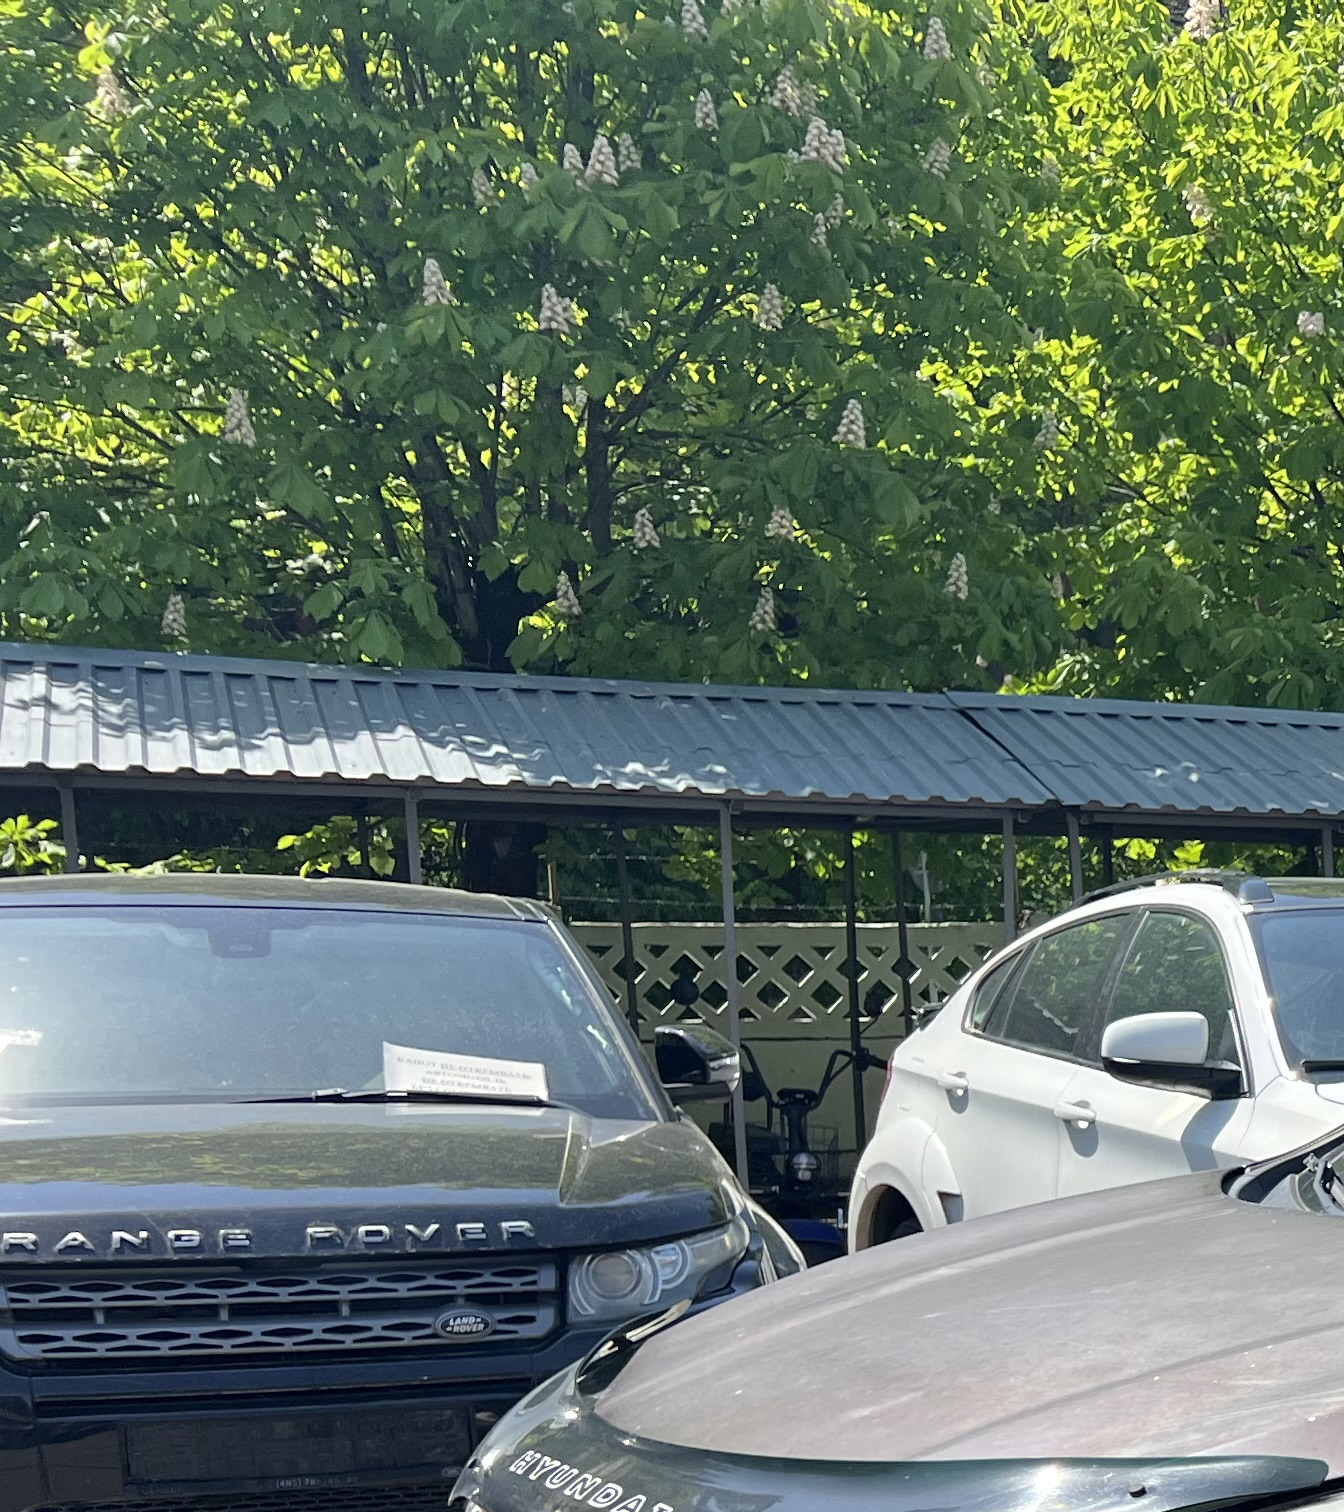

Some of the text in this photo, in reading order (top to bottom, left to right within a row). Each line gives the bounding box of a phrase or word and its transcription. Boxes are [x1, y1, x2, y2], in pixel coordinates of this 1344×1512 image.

[2, 1220, 536, 1251] RANGE ROVER
[449, 1316, 476, 1326] LAND
[453, 1323, 485, 1333] ROVER
